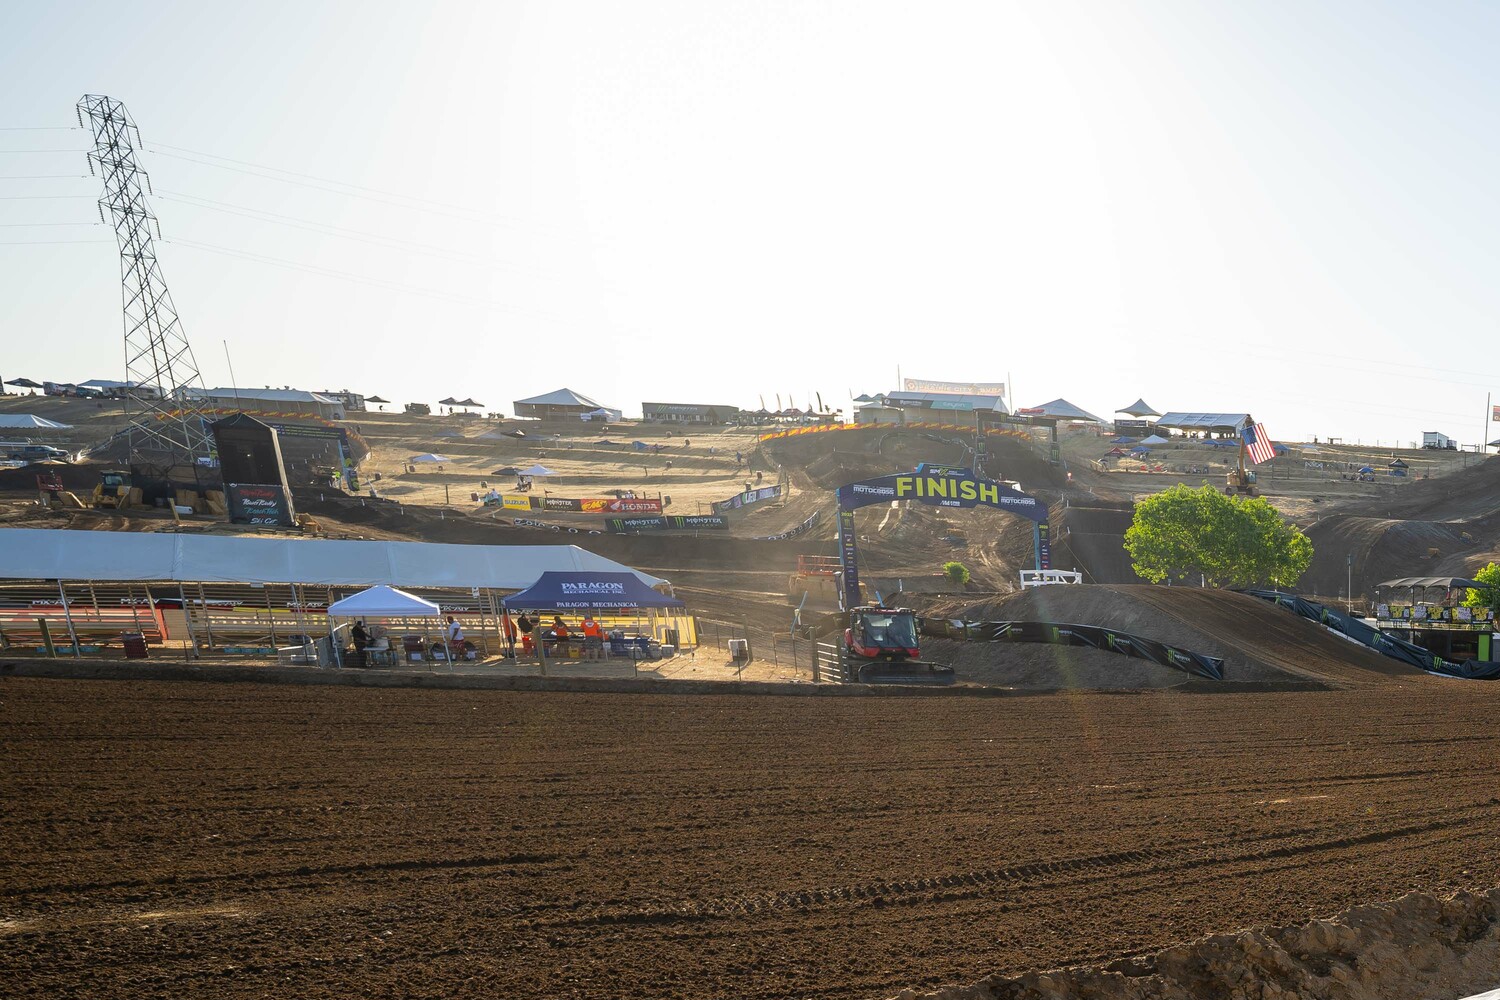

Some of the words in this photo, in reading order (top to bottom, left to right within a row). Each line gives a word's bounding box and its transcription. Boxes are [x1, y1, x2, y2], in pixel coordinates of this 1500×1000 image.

[853, 485, 895, 495] MOTOCROSS
[896, 477, 999, 504] FINISH
[1001, 497, 1036, 506] MOTOCROSS
[620, 503, 658, 511] HONDA
[561, 582, 623, 590] PARAGON
